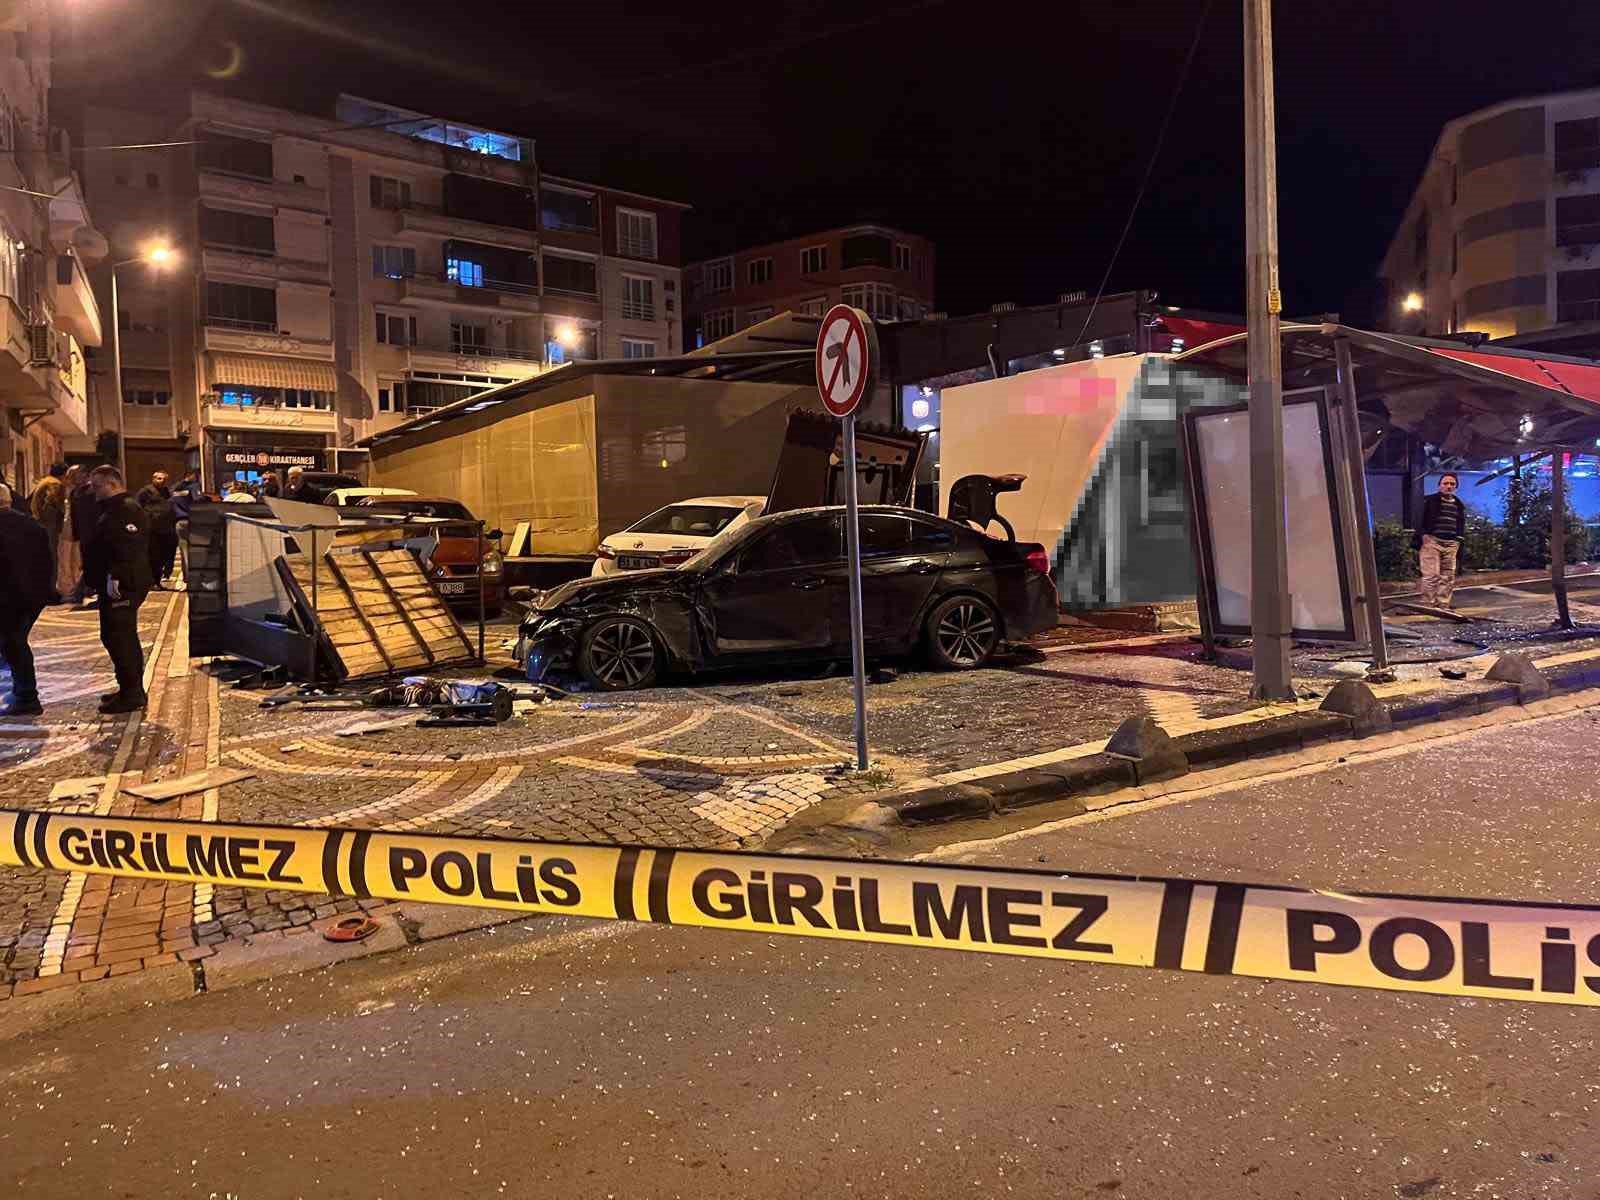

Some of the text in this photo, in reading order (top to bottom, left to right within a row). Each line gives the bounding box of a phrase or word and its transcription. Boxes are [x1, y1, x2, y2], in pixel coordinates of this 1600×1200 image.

[226, 454, 256, 465] GENÇLER
[269, 455, 315, 465] KIRAATHANESİ
[1285, 908, 1600, 995] POLİ
